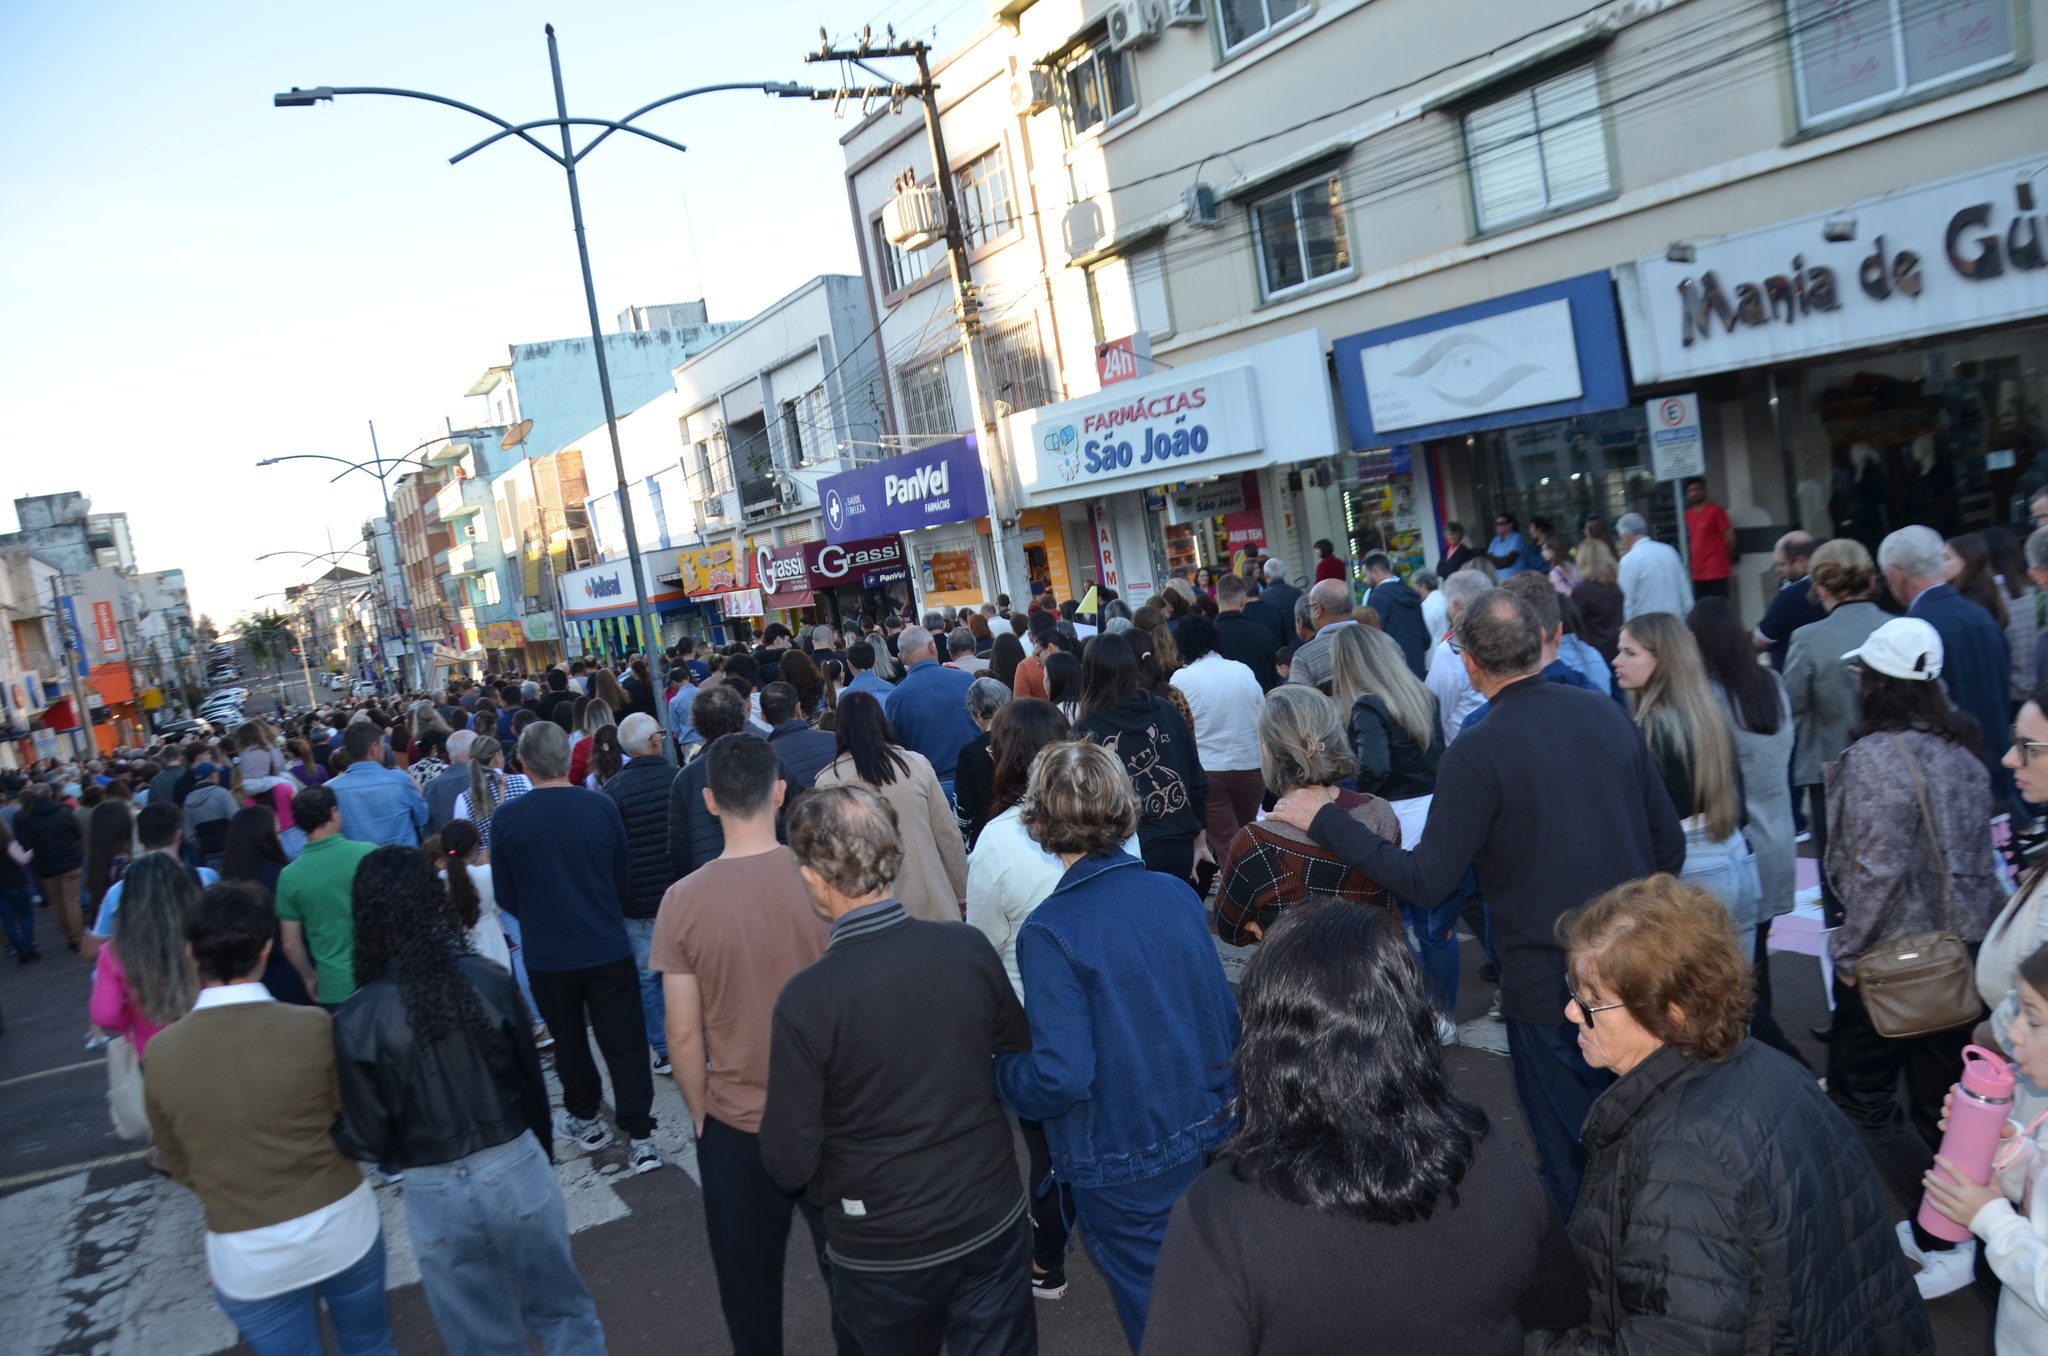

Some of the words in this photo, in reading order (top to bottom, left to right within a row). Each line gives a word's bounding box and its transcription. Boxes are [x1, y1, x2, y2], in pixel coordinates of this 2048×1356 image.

[1677, 254, 1842, 347] Mania
[1859, 234, 1923, 299] de
[1945, 202, 2048, 281] Gu
[1103, 344, 1133, 380] 24h
[1083, 387, 1206, 433] FARMÁCIAS
[1667, 403, 1680, 420] E
[1084, 431, 1133, 474] São
[1140, 414, 1208, 464] João
[885, 460, 949, 507] PanVel
[925, 499, 951, 514] FARMÁCIAS
[1229, 529, 1248, 542] AQUI
[1248, 528, 1264, 541] TEM
[757, 545, 806, 595] Grassi
[811, 541, 900, 578] Grassi
[880, 571, 906, 582] PanVel
